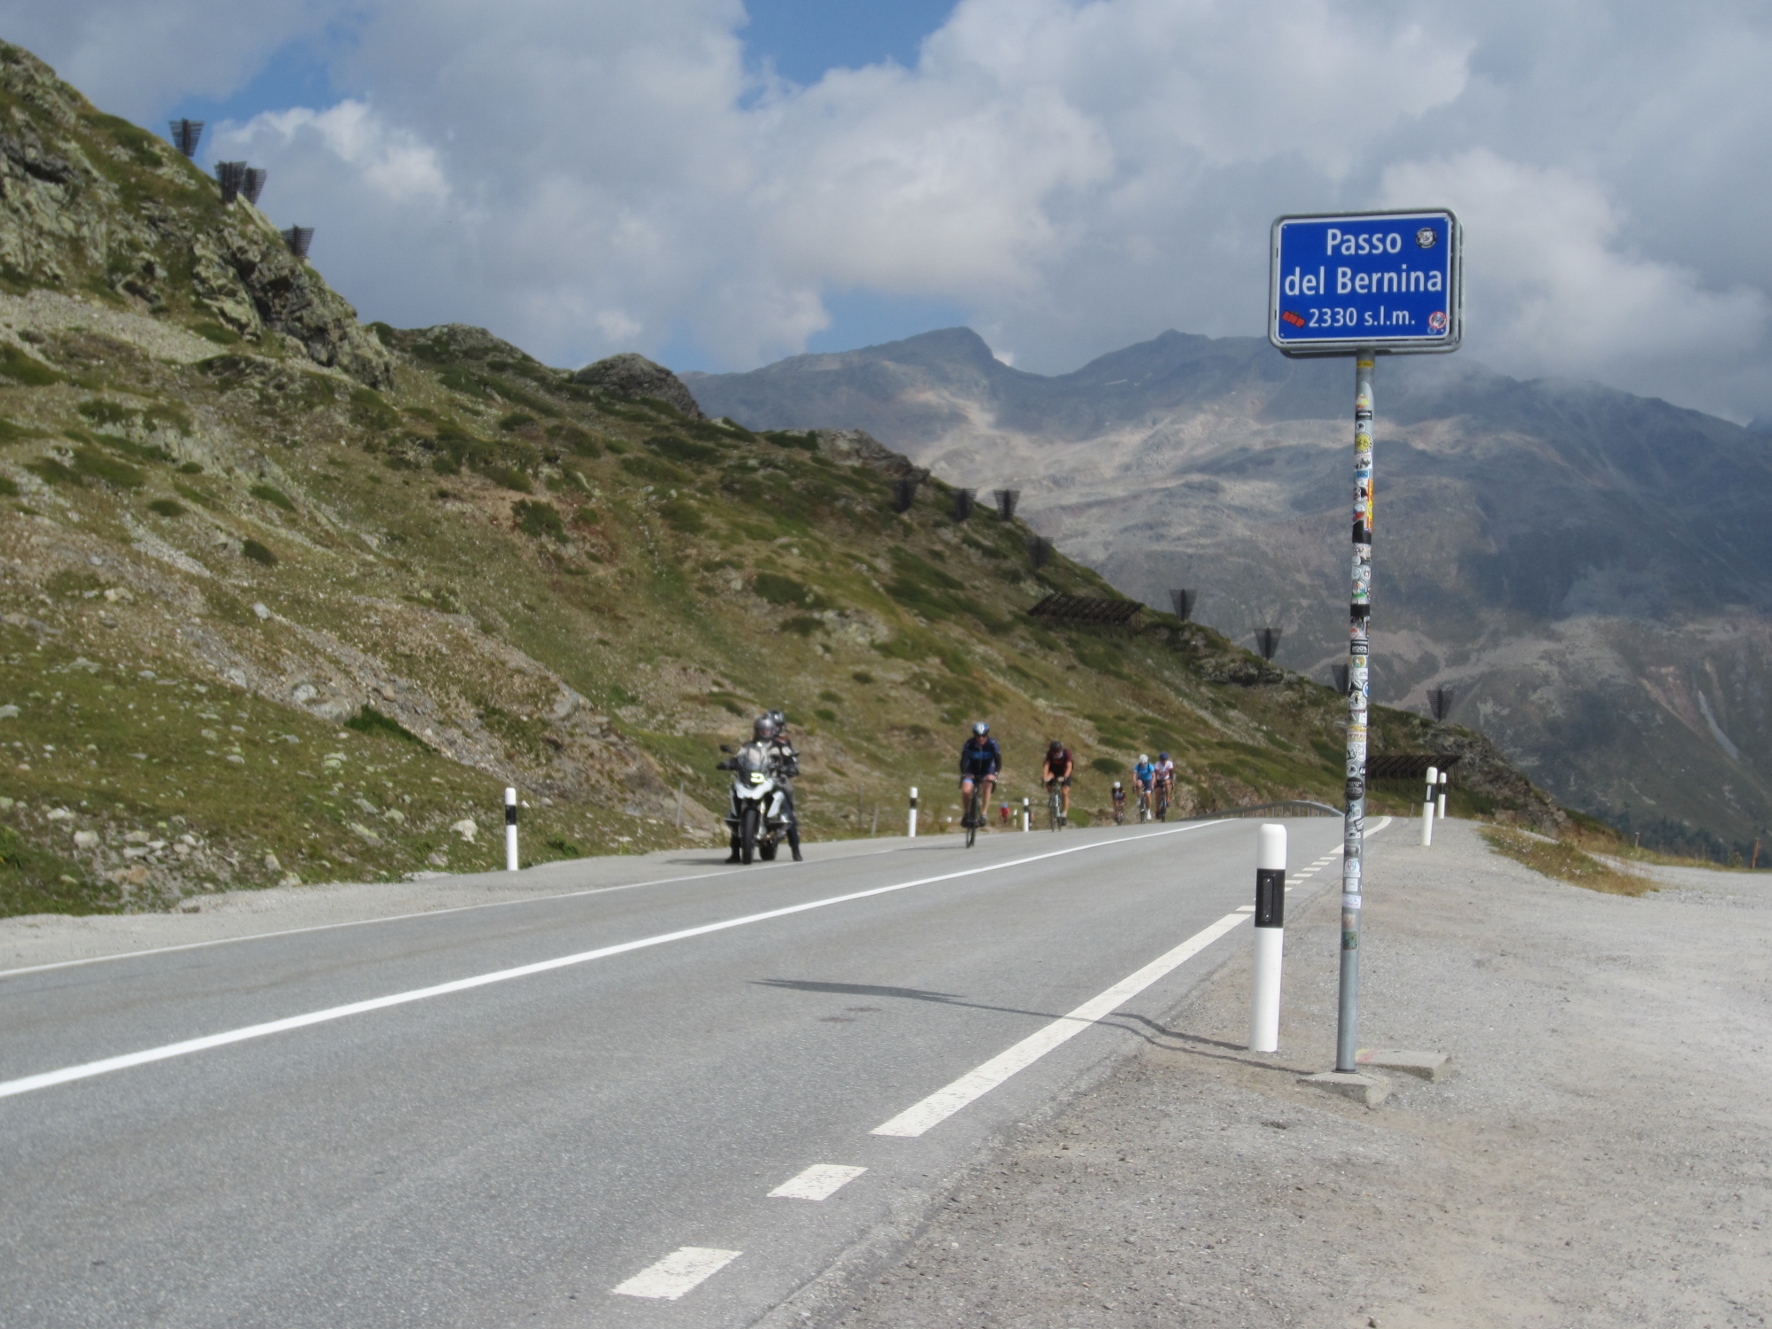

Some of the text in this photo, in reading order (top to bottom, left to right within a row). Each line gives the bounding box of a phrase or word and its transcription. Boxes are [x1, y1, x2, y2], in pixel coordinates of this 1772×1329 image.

[1326, 228, 1402, 256] Passo
[1284, 264, 1442, 296] del Bernina
[1308, 307, 1357, 328] 2330
[1364, 305, 1416, 326] s.l.m.
